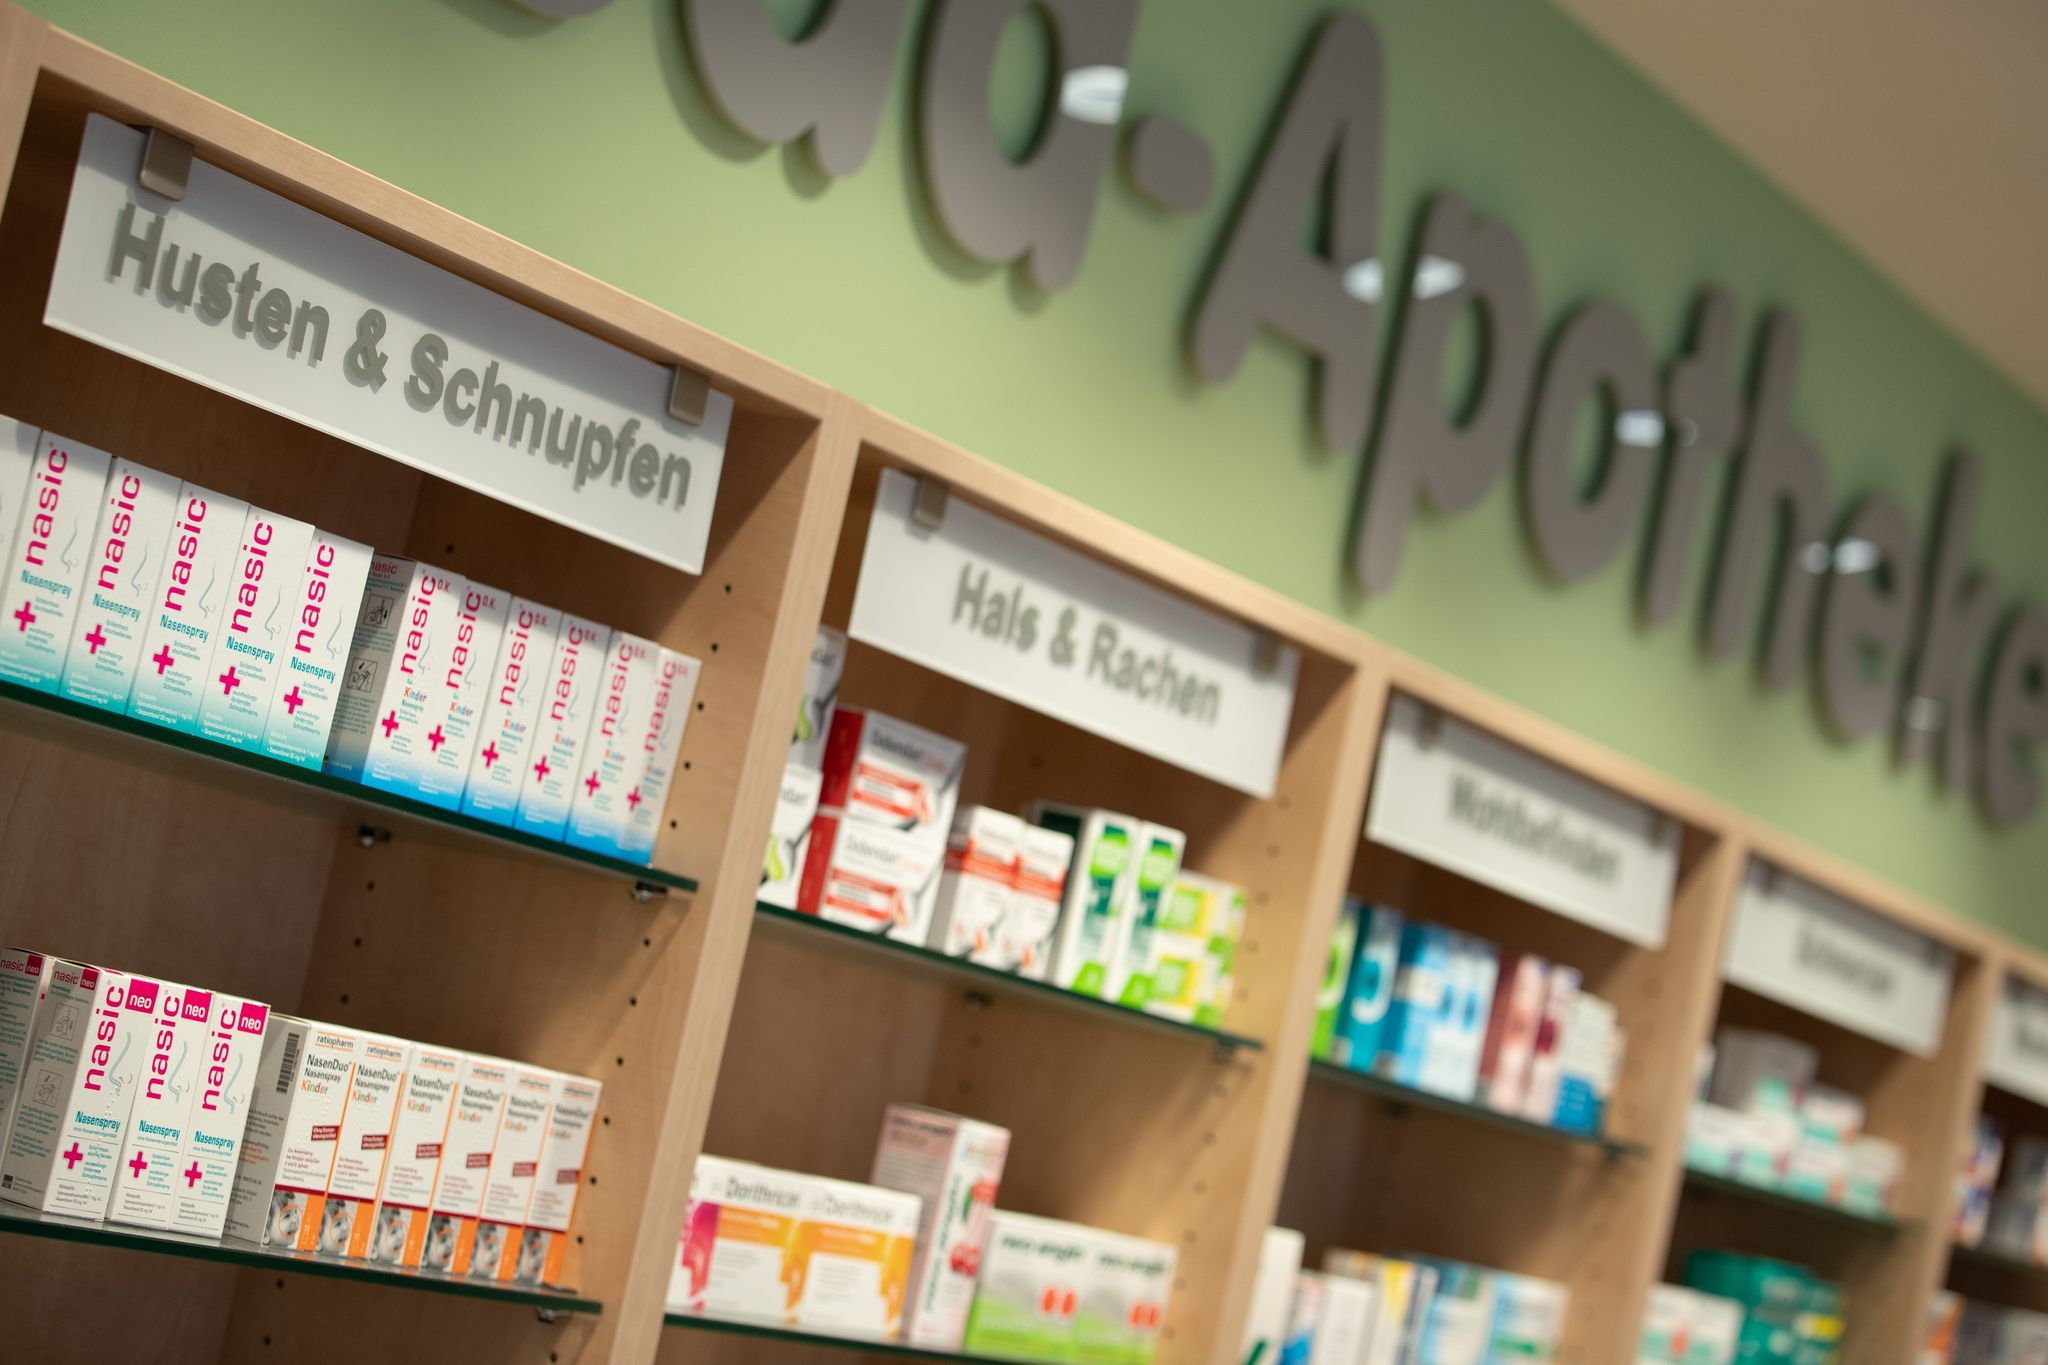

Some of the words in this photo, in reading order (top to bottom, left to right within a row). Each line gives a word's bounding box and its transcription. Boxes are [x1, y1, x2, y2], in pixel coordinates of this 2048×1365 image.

[107, 201, 330, 363] Husten
[344, 308, 389, 394] &
[405, 333, 693, 510] Schnupfen
[21, 569, 73, 600] Nasenspray
[92, 592, 142, 622] Nasenspray
[160, 614, 209, 643] Nasenspray
[400, 575, 436, 674] nasic
[226, 636, 275, 665] Nasenspray
[445, 591, 481, 690] nasic
[950, 562, 1041, 653] Hals
[1049, 605, 1077, 669] &
[1086, 622, 1221, 726] Rachen
[499, 609, 534, 706] nasic
[290, 656, 336, 683] Nasenspray
[551, 624, 584, 721] nasic
[403, 687, 428, 703] Kinder
[449, 702, 474, 718] Kinder
[54, 969, 79, 985] nasic
[81, 978, 96, 989] neo
[129, 992, 152, 1009] neo
[184, 1002, 205, 1018] neo
[241, 1015, 261, 1031] neo
[84, 985, 124, 1091] nasic
[145, 995, 180, 1100] nasic
[316, 1034, 354, 1049] ratiopharm
[202, 1009, 237, 1111] nasic
[367, 1045, 402, 1060] ratiopharm
[304, 1068, 341, 1085] Nasenspray
[355, 1078, 389, 1094] Nasenspray
[300, 1080, 328, 1095] Kinder
[352, 1090, 377, 1105] Kinder
[407, 1099, 432, 1114] Kinder
[75, 1111, 120, 1133] Nasenspray
[138, 1120, 180, 1141] Nasenspray
[194, 1131, 235, 1151] Nasenspray
